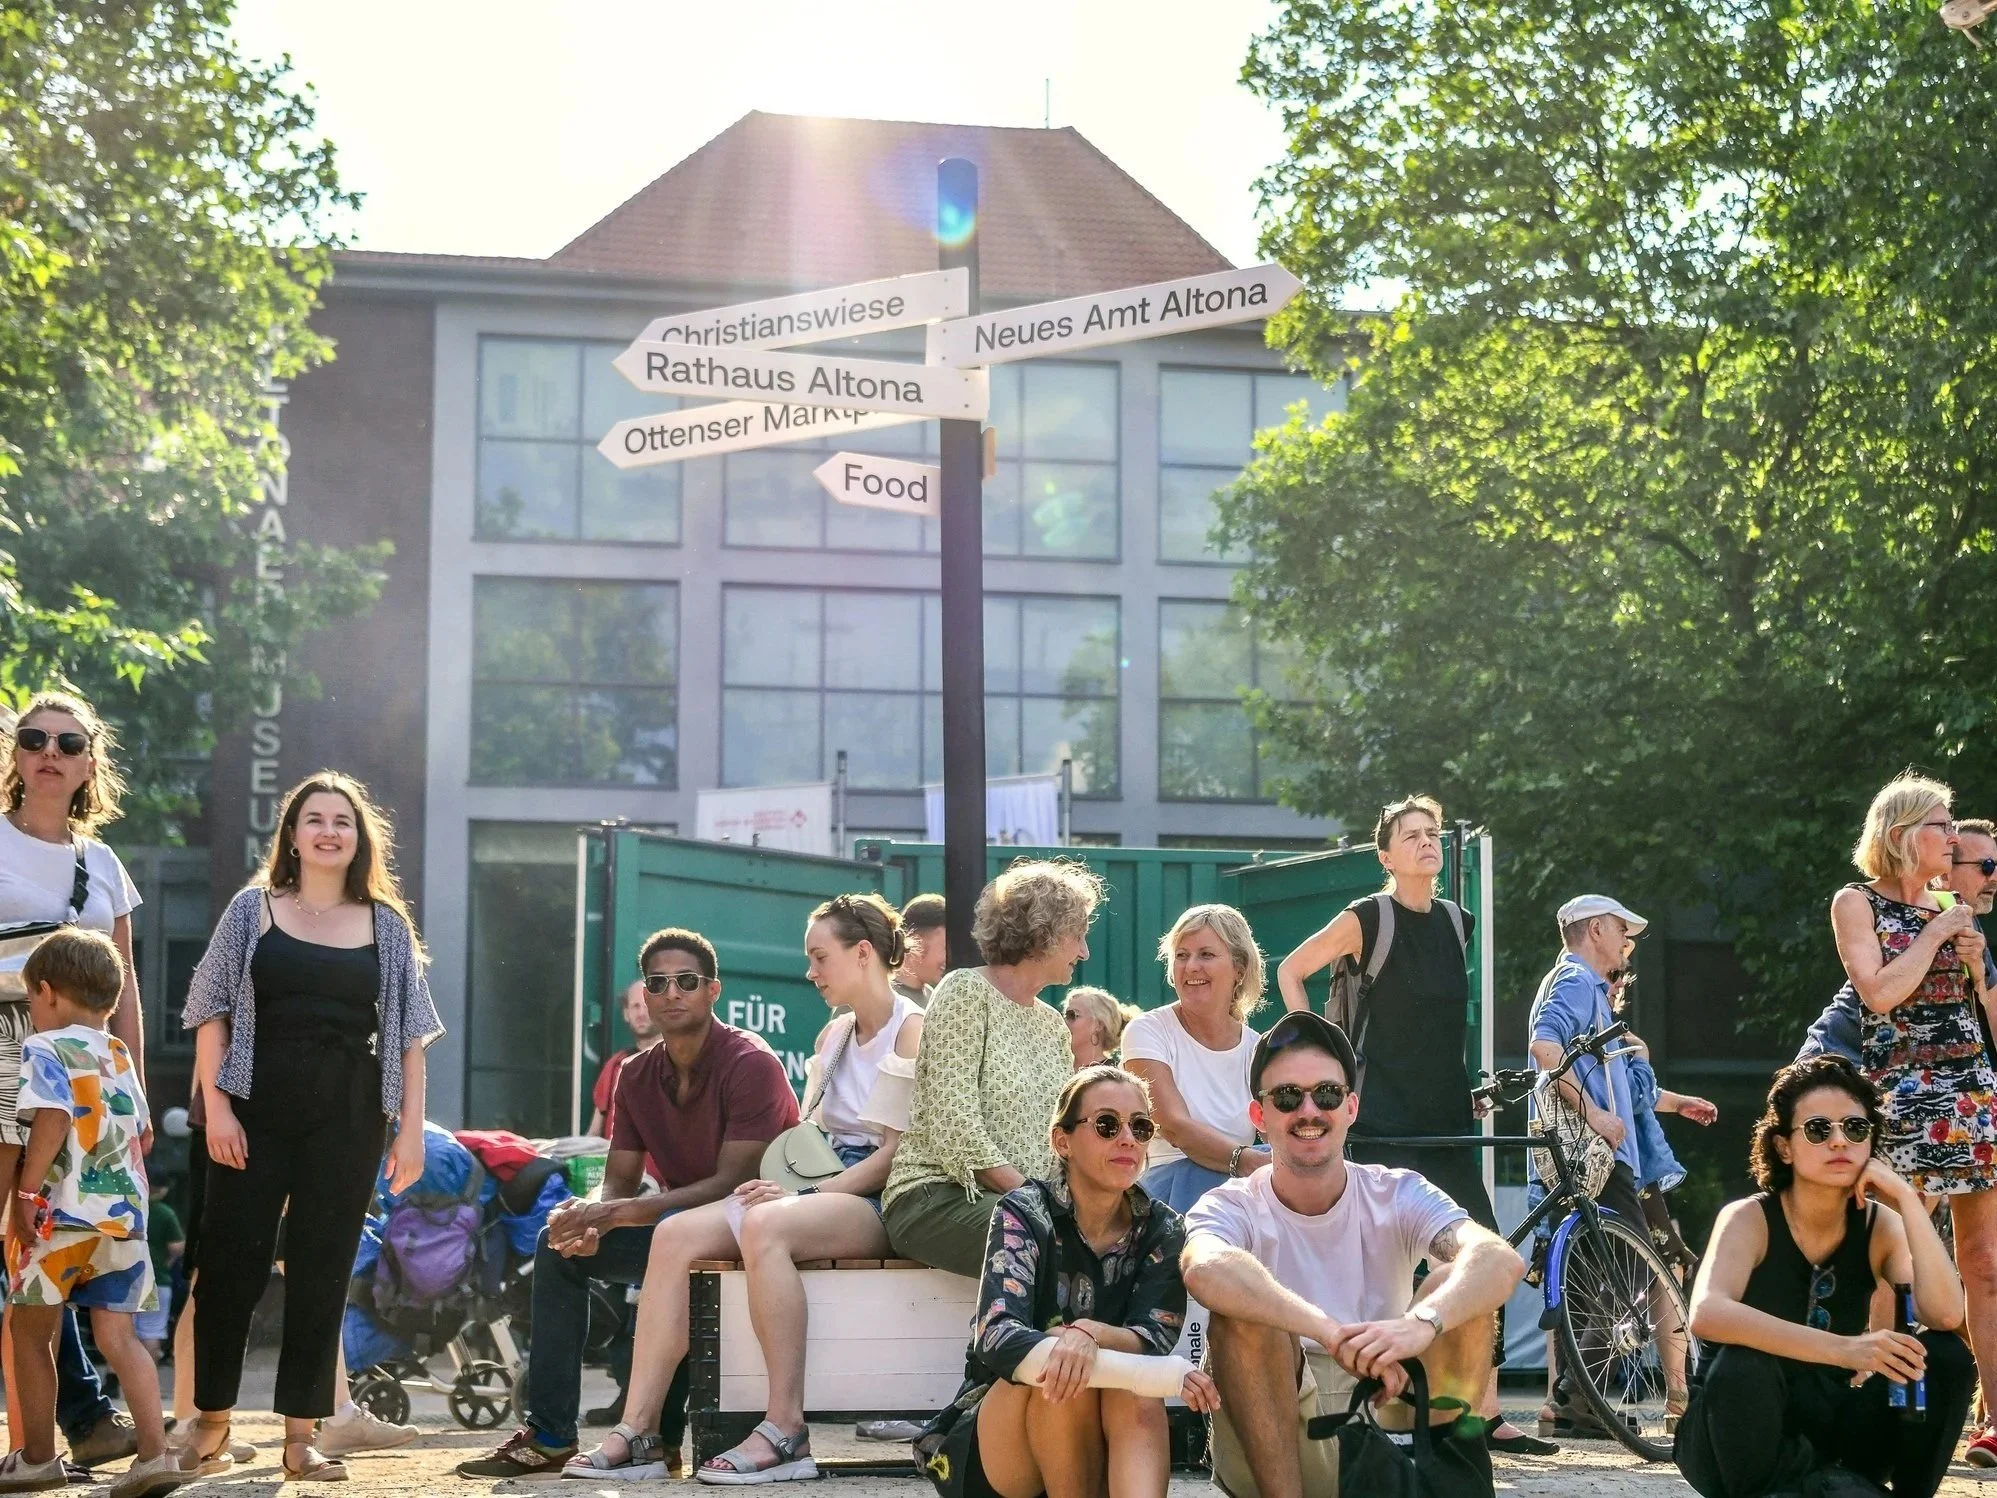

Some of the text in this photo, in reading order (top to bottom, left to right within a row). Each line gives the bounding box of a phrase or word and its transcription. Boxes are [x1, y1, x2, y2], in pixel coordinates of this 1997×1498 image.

[662, 295, 905, 346] Christianswiese
[976, 283, 1268, 353] Neues Amt Altona
[646, 352, 924, 403] Rathaus Altona
[624, 414, 754, 454] Ottenser
[844, 463, 928, 503] Food
[728, 994, 786, 1034] FÜR
